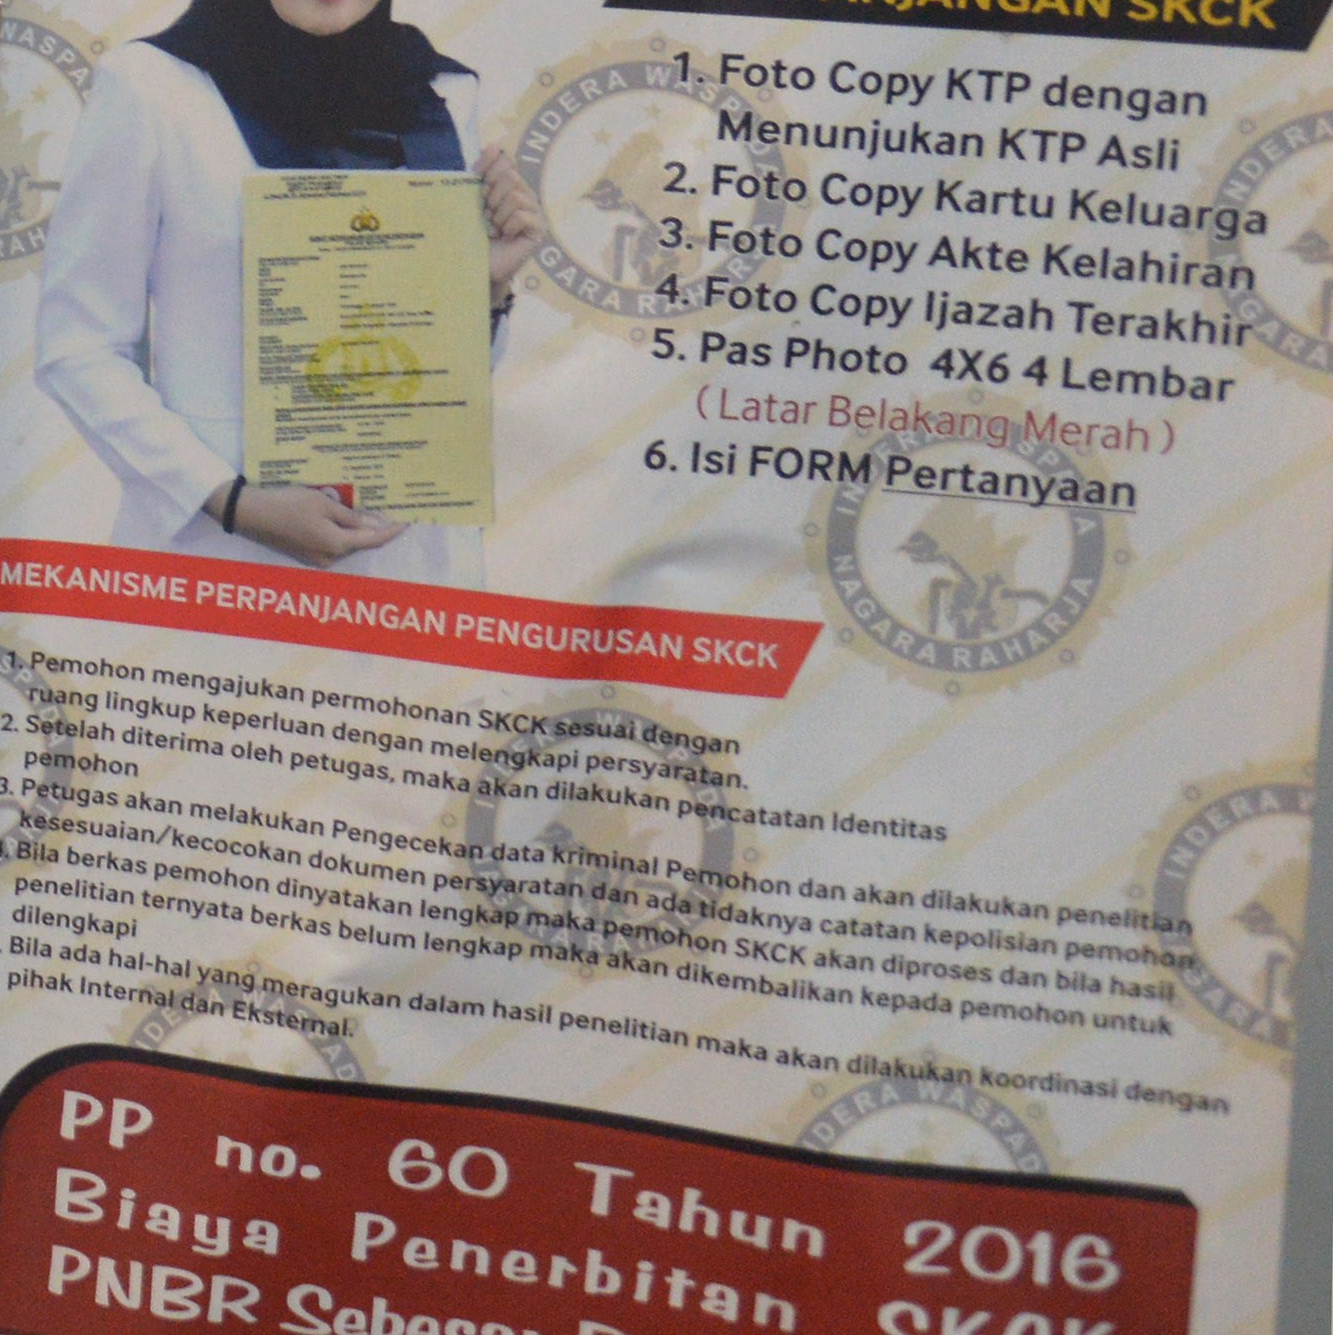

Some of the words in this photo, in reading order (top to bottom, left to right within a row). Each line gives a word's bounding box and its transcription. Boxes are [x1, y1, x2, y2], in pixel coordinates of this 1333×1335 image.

[674, 52, 704, 84] 1.
[720, 53, 815, 91] Foto
[829, 61, 934, 106] Copy
[947, 67, 1031, 103] KTP
[1043, 75, 1207, 122] dengan
[718, 109, 983, 159] Menunjukan
[999, 128, 1086, 164] KTP
[1097, 135, 1179, 171] Asli
[664, 161, 697, 195] 2.
[712, 164, 807, 203] Foto
[821, 172, 923, 218] Copy
[936, 179, 1054, 219] Kartu
[1070, 188, 1267, 241] Keluarga
[659, 216, 693, 250] 3.
[709, 219, 802, 258] Foto
[816, 228, 918, 273] Copy
[928, 236, 1029, 274] Akte
[1044, 243, 1255, 292] Kelahiran
[655, 273, 689, 306] 4.
[705, 275, 797, 314] Foto
[810, 283, 912, 329] Copy
[926, 290, 1053, 331] Ijazah
[1068, 301, 1252, 347] Terakhir
[652, 327, 685, 361] 5.
[701, 330, 771, 367] Pas
[785, 337, 908, 376] Photo
[930, 348, 1009, 384] 4X6
[1023, 356, 1048, 387] 4
[1062, 356, 1234, 402] Lembar
[720, 387, 817, 425] Latar
[828, 394, 1011, 444] Belakang
[1023, 411, 1151, 453] Merah
[644, 440, 677, 472] 6.
[692, 441, 736, 475] Isi
[750, 445, 871, 484] FORM
[887, 454, 1135, 508] Pertanyaan
[1, 561, 187, 603] MEKANISME
[196, 580, 446, 636] PERPANJANGAN
[456, 613, 683, 660] PENGURUSAN
[693, 636, 777, 669] SKCK
[7, 650, 23, 670] 1.
[30, 651, 145, 682] Pemohon
[153, 669, 304, 702] mengajukan
[312, 689, 470, 726] permohonan
[479, 709, 547, 736] SKCK
[554, 715, 636, 741] sesuai
[642, 723, 740, 758] dengan
[1, 713, 18, 732] 2.
[26, 714, 114, 742] Setelah
[122, 726, 223, 756] diterima
[231, 741, 282, 764] oleh
[290, 752, 394, 783] petugas,
[403, 769, 470, 794] maka
[476, 775, 538, 799] akan
[546, 781, 669, 812] dilakukan
[678, 799, 824, 830] pencatatan
[833, 811, 947, 842] Identitas
[24, 751, 138, 777] pemohon
[8, 969, 72, 993] pihak
[80, 976, 174, 1008] Internal
[181, 991, 225, 1016] dan
[233, 999, 355, 1038] Eksternal.
[59, 1089, 154, 1150] PP
[214, 1134, 323, 1181] no.
[387, 1138, 510, 1199] 60
[573, 1162, 826, 1260] Tahun
[903, 1219, 1122, 1293] 2016
[54, 1167, 280, 1257] Biaya
[350, 1211, 798, 1333] Penerbitan
[47, 1244, 262, 1325] PNBR
[278, 1283, 540, 1335] Sebes
